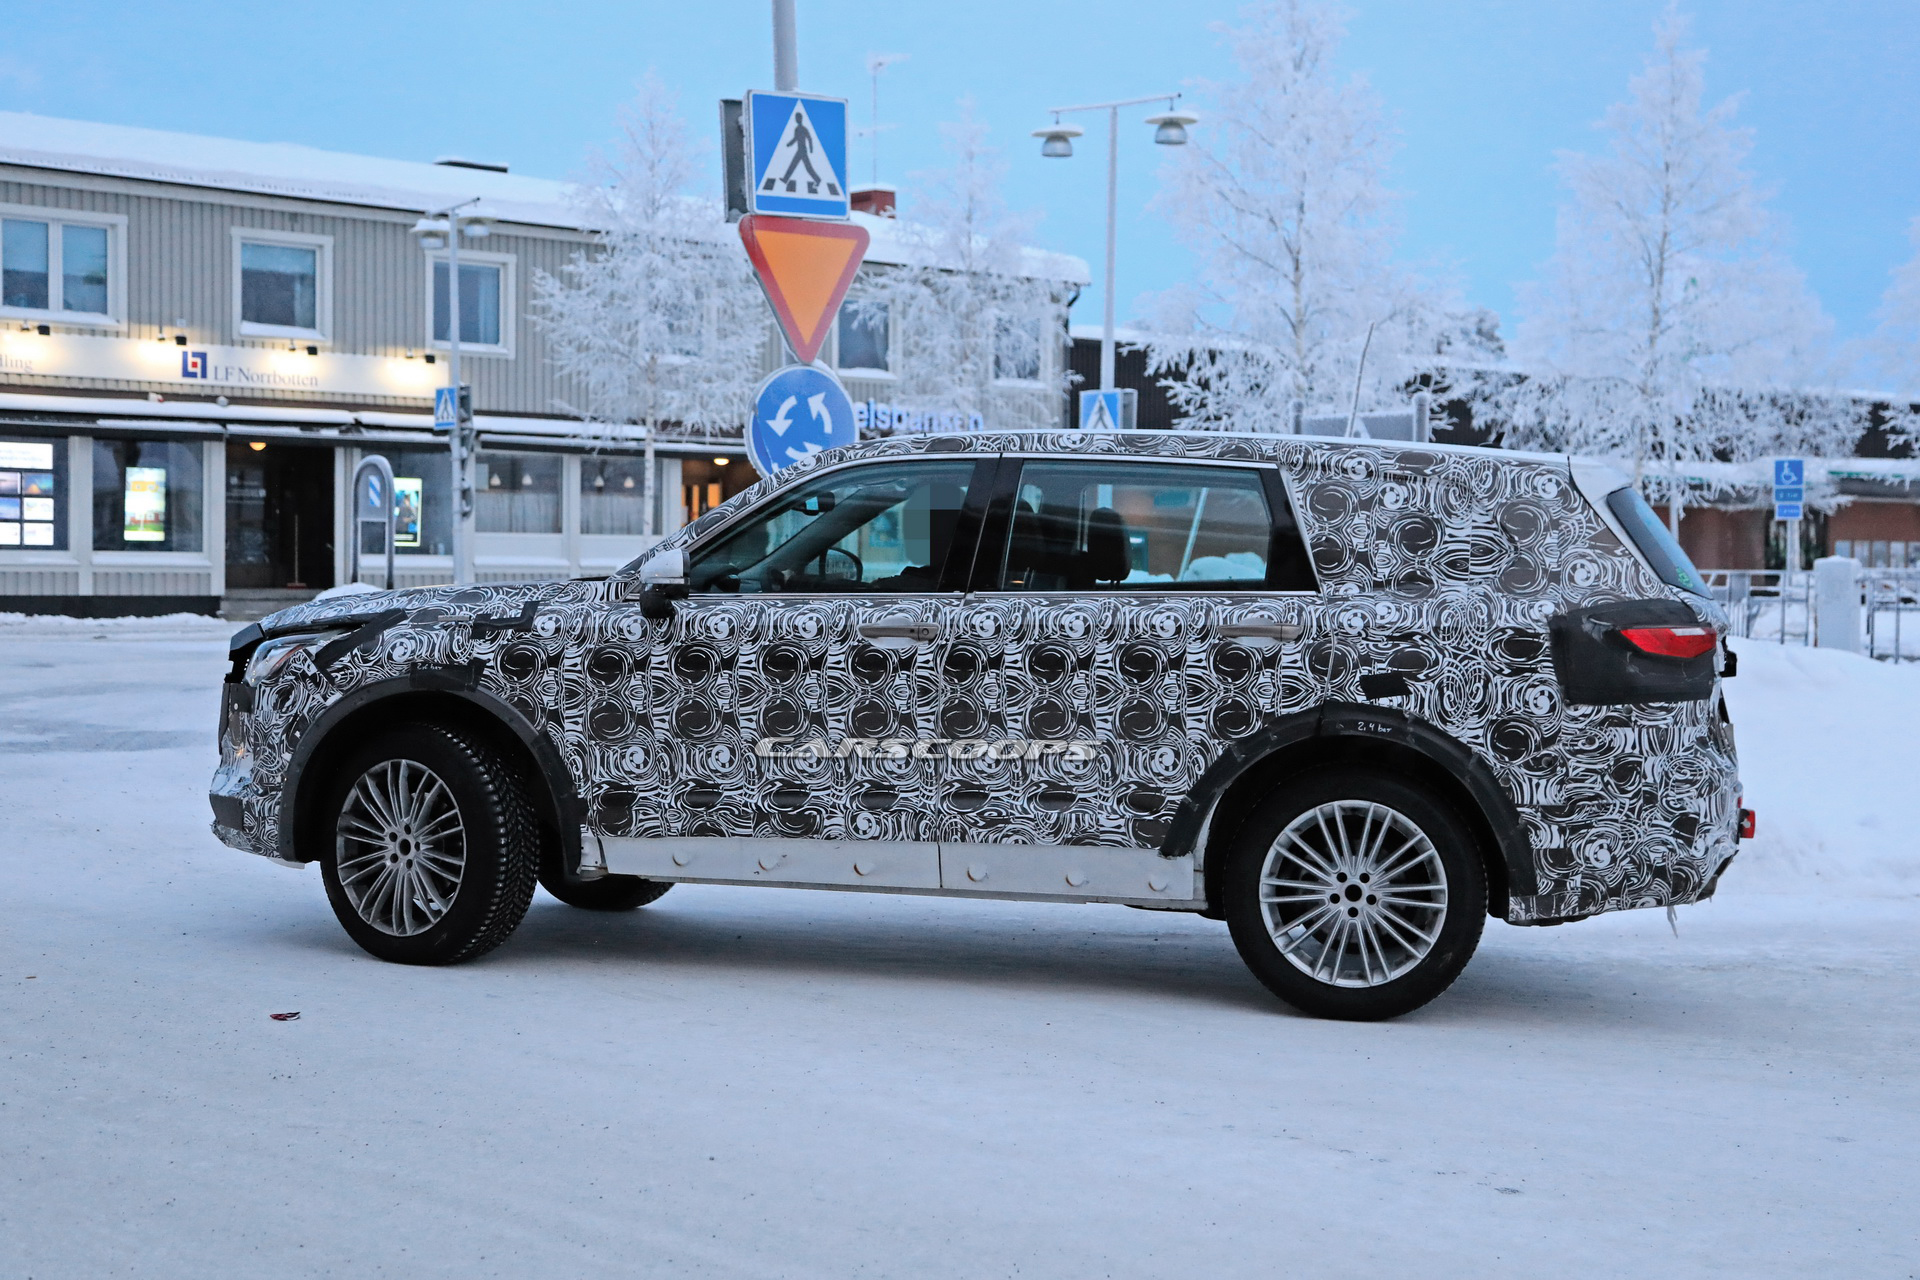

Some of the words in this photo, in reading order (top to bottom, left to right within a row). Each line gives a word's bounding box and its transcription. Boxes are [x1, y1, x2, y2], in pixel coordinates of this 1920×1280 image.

[214, 365, 235, 381] LF
[238, 367, 319, 388] Norrbotten
[1377, 723, 1392, 732] bar
